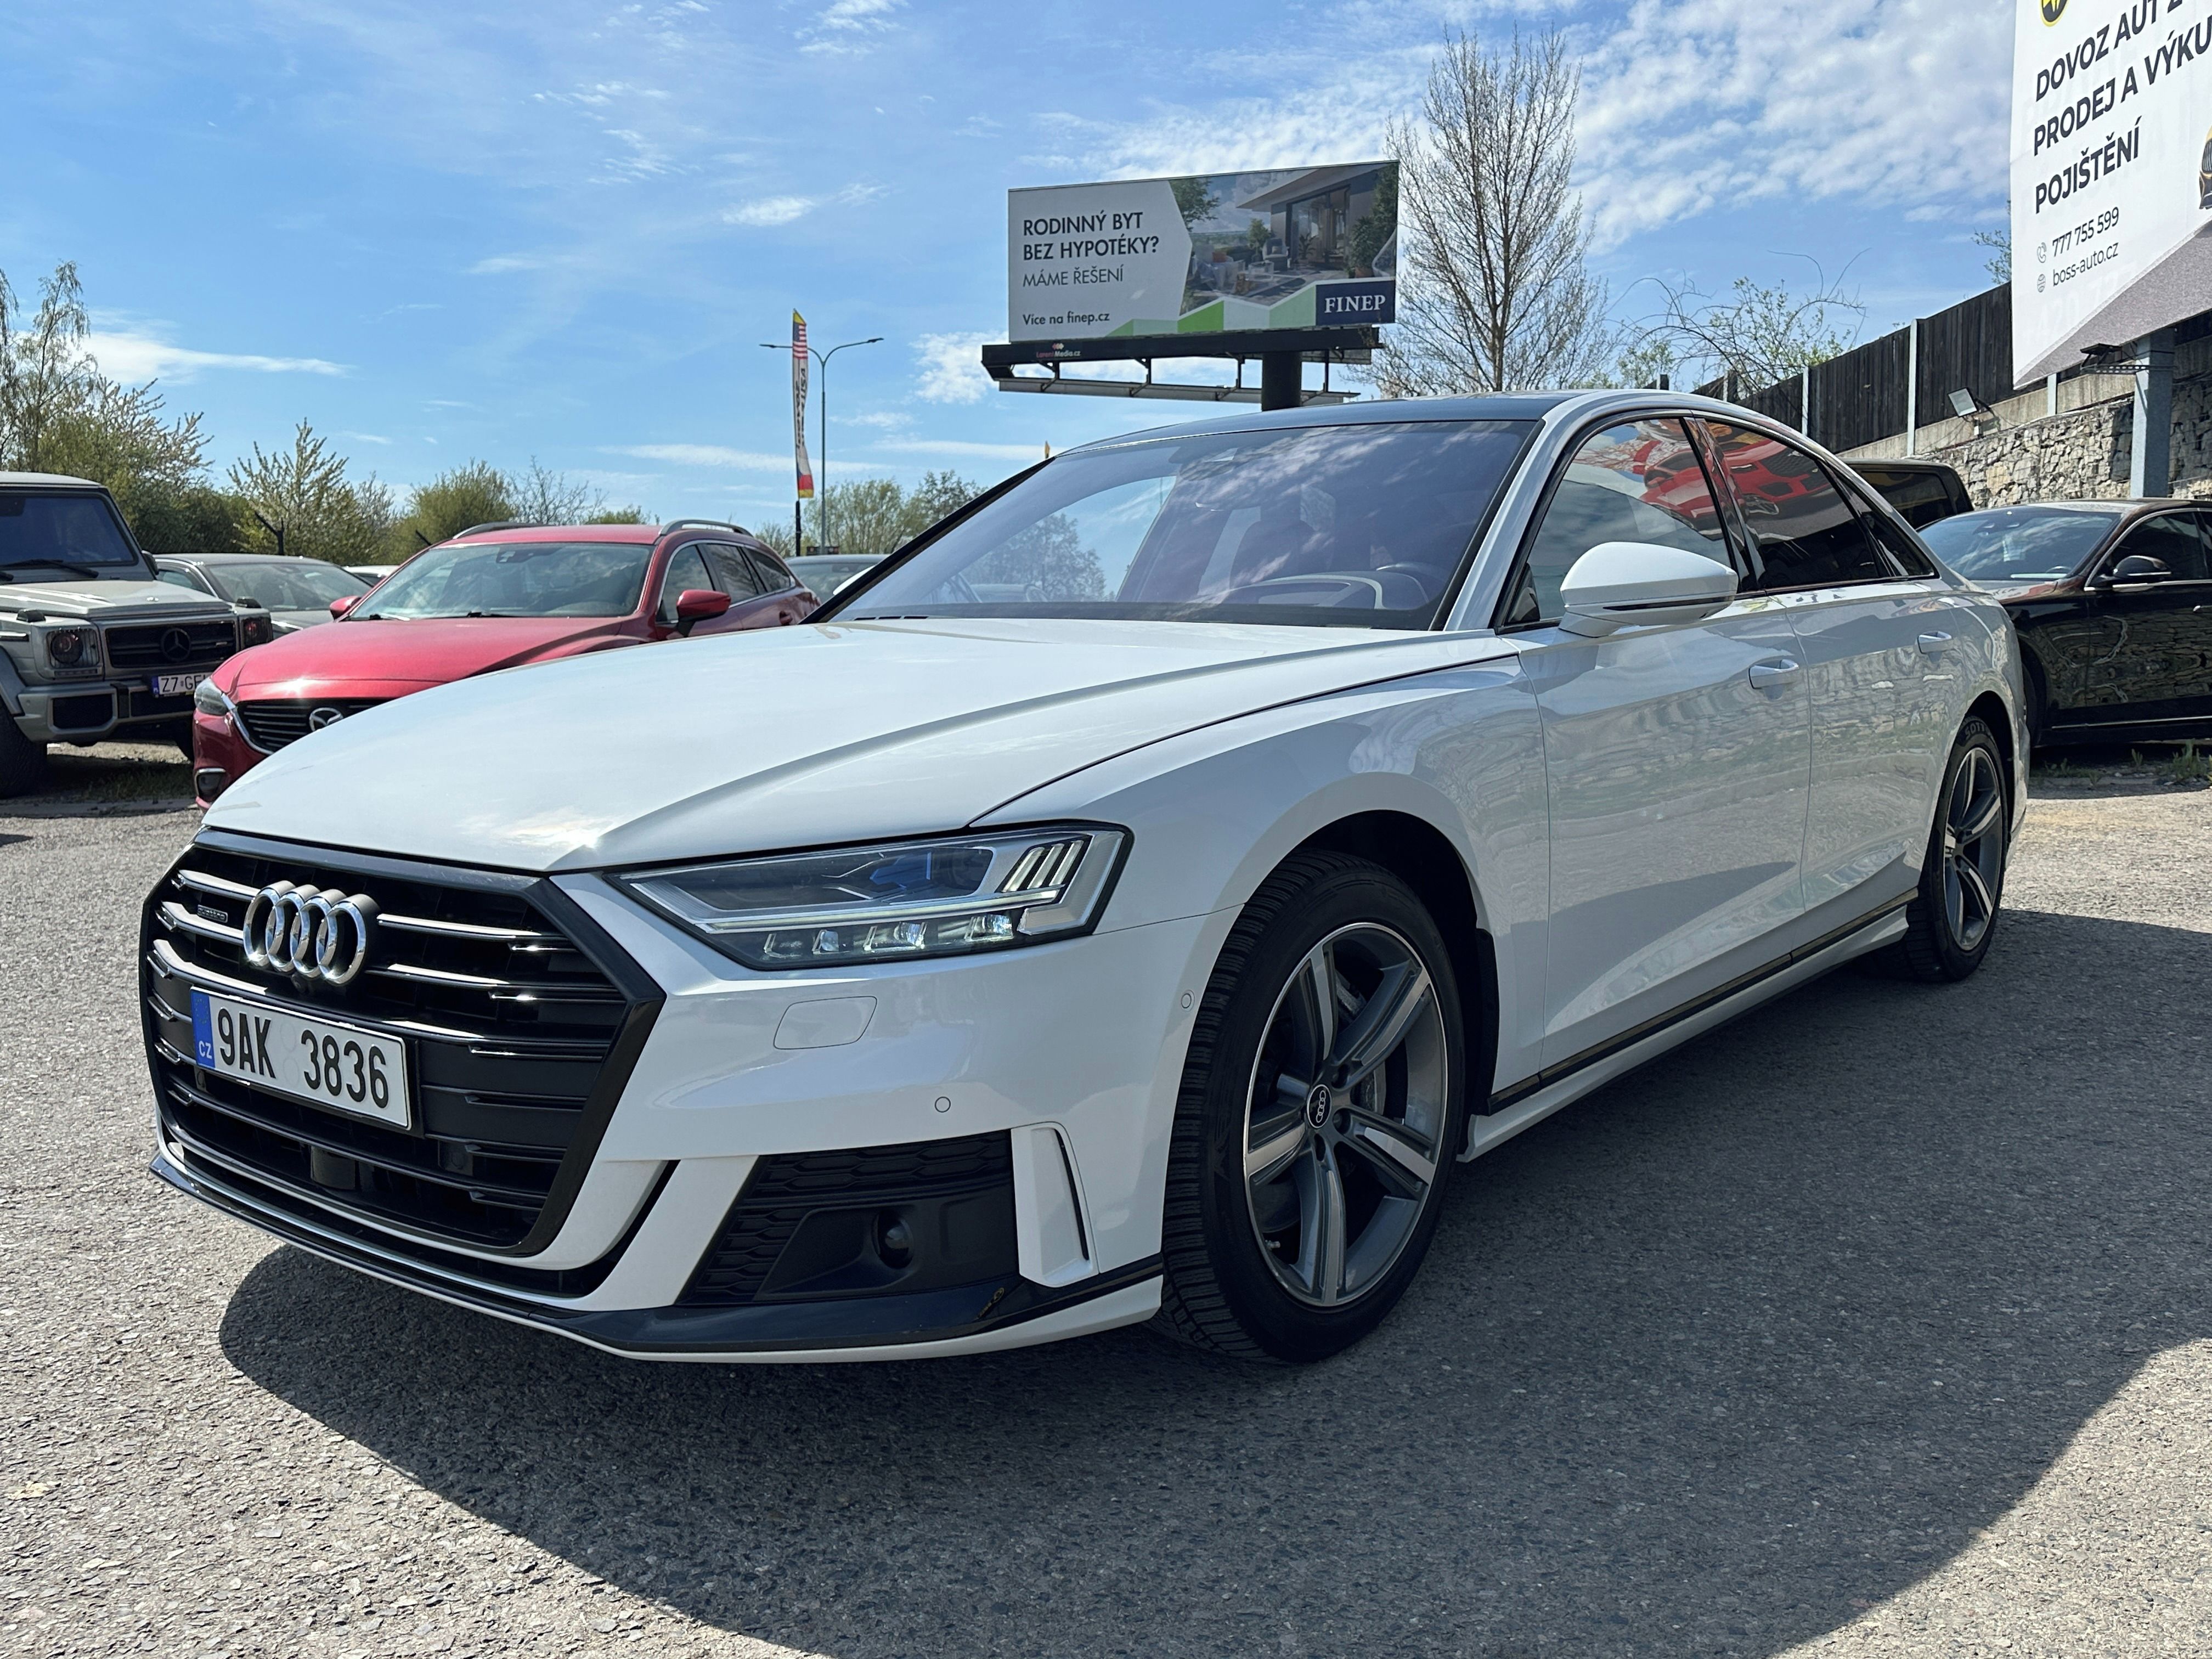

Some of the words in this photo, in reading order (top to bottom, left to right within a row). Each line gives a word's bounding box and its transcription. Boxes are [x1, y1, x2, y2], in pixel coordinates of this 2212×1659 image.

[2036, 24, 2110, 102] DOVOZ
[2114, 0, 2157, 49] AUT
[2034, 77, 2116, 156] PRODEJ
[2120, 66, 2138, 103] A
[2144, 15, 2212, 85] VÝKU
[2035, 115, 2142, 215] POJIŠTĚNÍ
[1024, 210, 1107, 236] RODINNÝ
[1113, 212, 1143, 230] BYT
[2052, 230, 2072, 257] 777
[2074, 219, 2095, 246] 755
[2097, 207, 2119, 234] 599
[1024, 243, 1054, 261] BEZ
[1060, 233, 1159, 258] HYPOTÉKY?
[1023, 269, 1069, 287] MÁME
[1073, 264, 1124, 284] ŘEŠENÍ
[2053, 242, 2119, 287] boss-auto.cz
[1023, 313, 1046, 325] Více
[1049, 315, 1063, 324] na
[1067, 311, 1110, 325] finep.cz
[1324, 295, 1386, 313] FINEP
[161, 677, 179, 693] Z7
[185, 674, 205, 690] GE
[199, 1040, 212, 1059] CZ
[217, 1008, 276, 1079] 9AK
[300, 1029, 390, 1109] 3836
